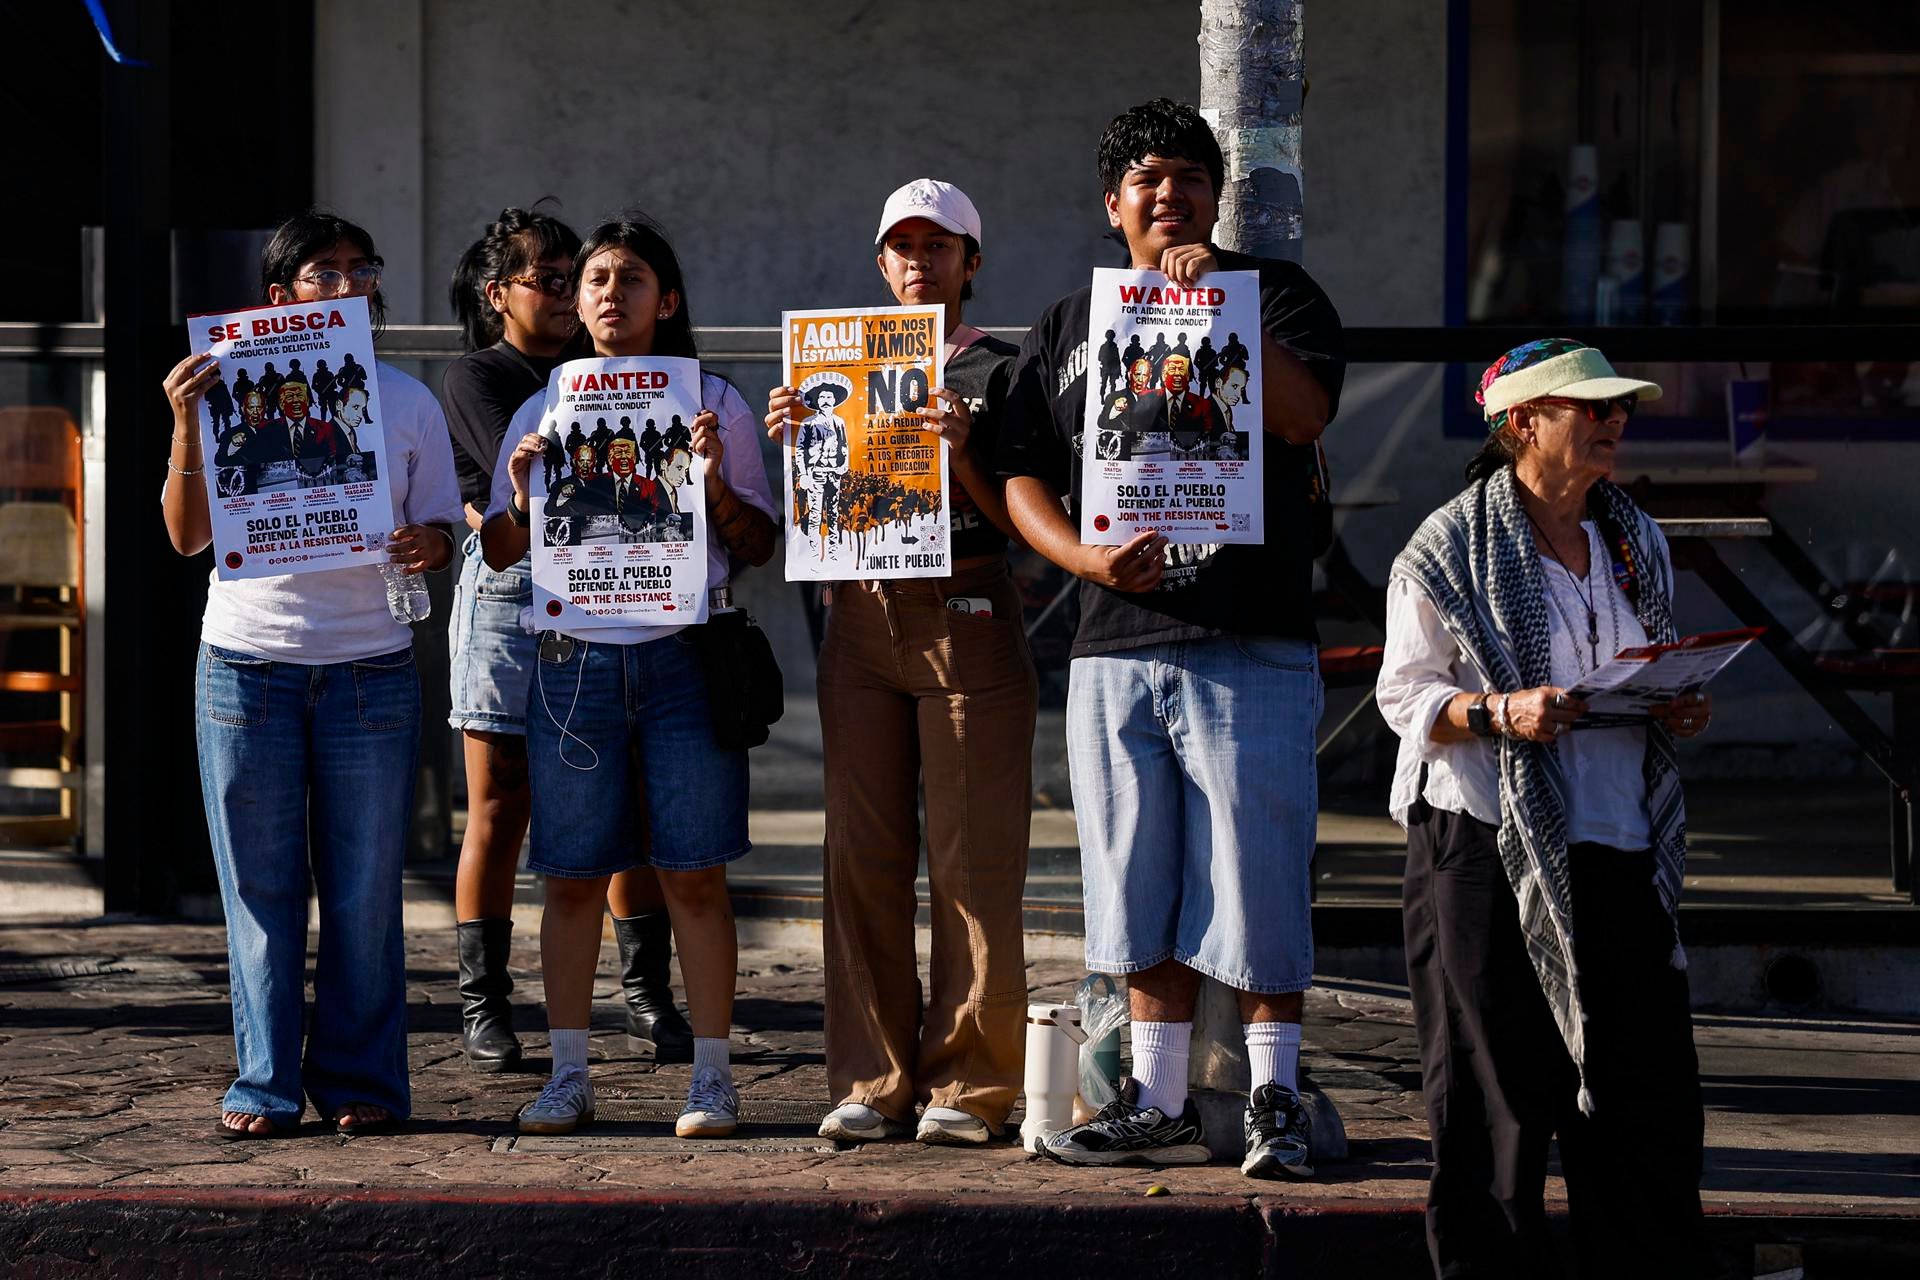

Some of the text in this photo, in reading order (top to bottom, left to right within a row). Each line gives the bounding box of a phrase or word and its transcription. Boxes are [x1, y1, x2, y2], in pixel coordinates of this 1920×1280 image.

[1119, 285, 1226, 306] WANTED
[1122, 306, 1221, 316] FOR AIDING AND ABETTING
[209, 311, 345, 343] SE BUSCA
[865, 319, 926, 333] Y NO NOS
[1136, 316, 1207, 326] CRIMINAL CONDUCT
[234, 332, 323, 349] POR COMPLICIDAD EN
[230, 342, 330, 359] CONDUCTAS DELICTIVAS
[802, 349, 862, 362] ESTAMOS
[562, 372, 668, 392] WANTED
[579, 393, 604, 401] AIDING
[626, 391, 664, 399] ABETTING
[868, 368, 929, 415] NO
[575, 403, 612, 411] CRIMINAL
[878, 419, 890, 428] LAS
[878, 436, 886, 445] LA
[890, 434, 920, 444] GUERRA
[879, 451, 891, 460] LOS
[896, 449, 934, 460] RECORTES
[870, 463, 874, 472] A
[879, 462, 886, 472] LA
[1117, 484, 1225, 497] SOLO EL PUEBLO
[1118, 497, 1225, 509] DEFIENDE AL PUEBLO
[247, 508, 357, 532] SOLO EL PUEBLO
[1117, 510, 1225, 522] JOIN THE RESISTANCE
[249, 522, 358, 544] DEFIENDE AL PUEBLO
[280, 542, 287, 551] A
[289, 540, 301, 549] LA
[304, 534, 362, 548] RESISTENCIA
[905, 553, 945, 568] PUEBLO!
[568, 565, 671, 581] SOLO EL PUEBLO
[569, 580, 671, 592] DEFIENDE AL PUEBLO
[569, 592, 671, 605] JOIN THE RESISTANCE
